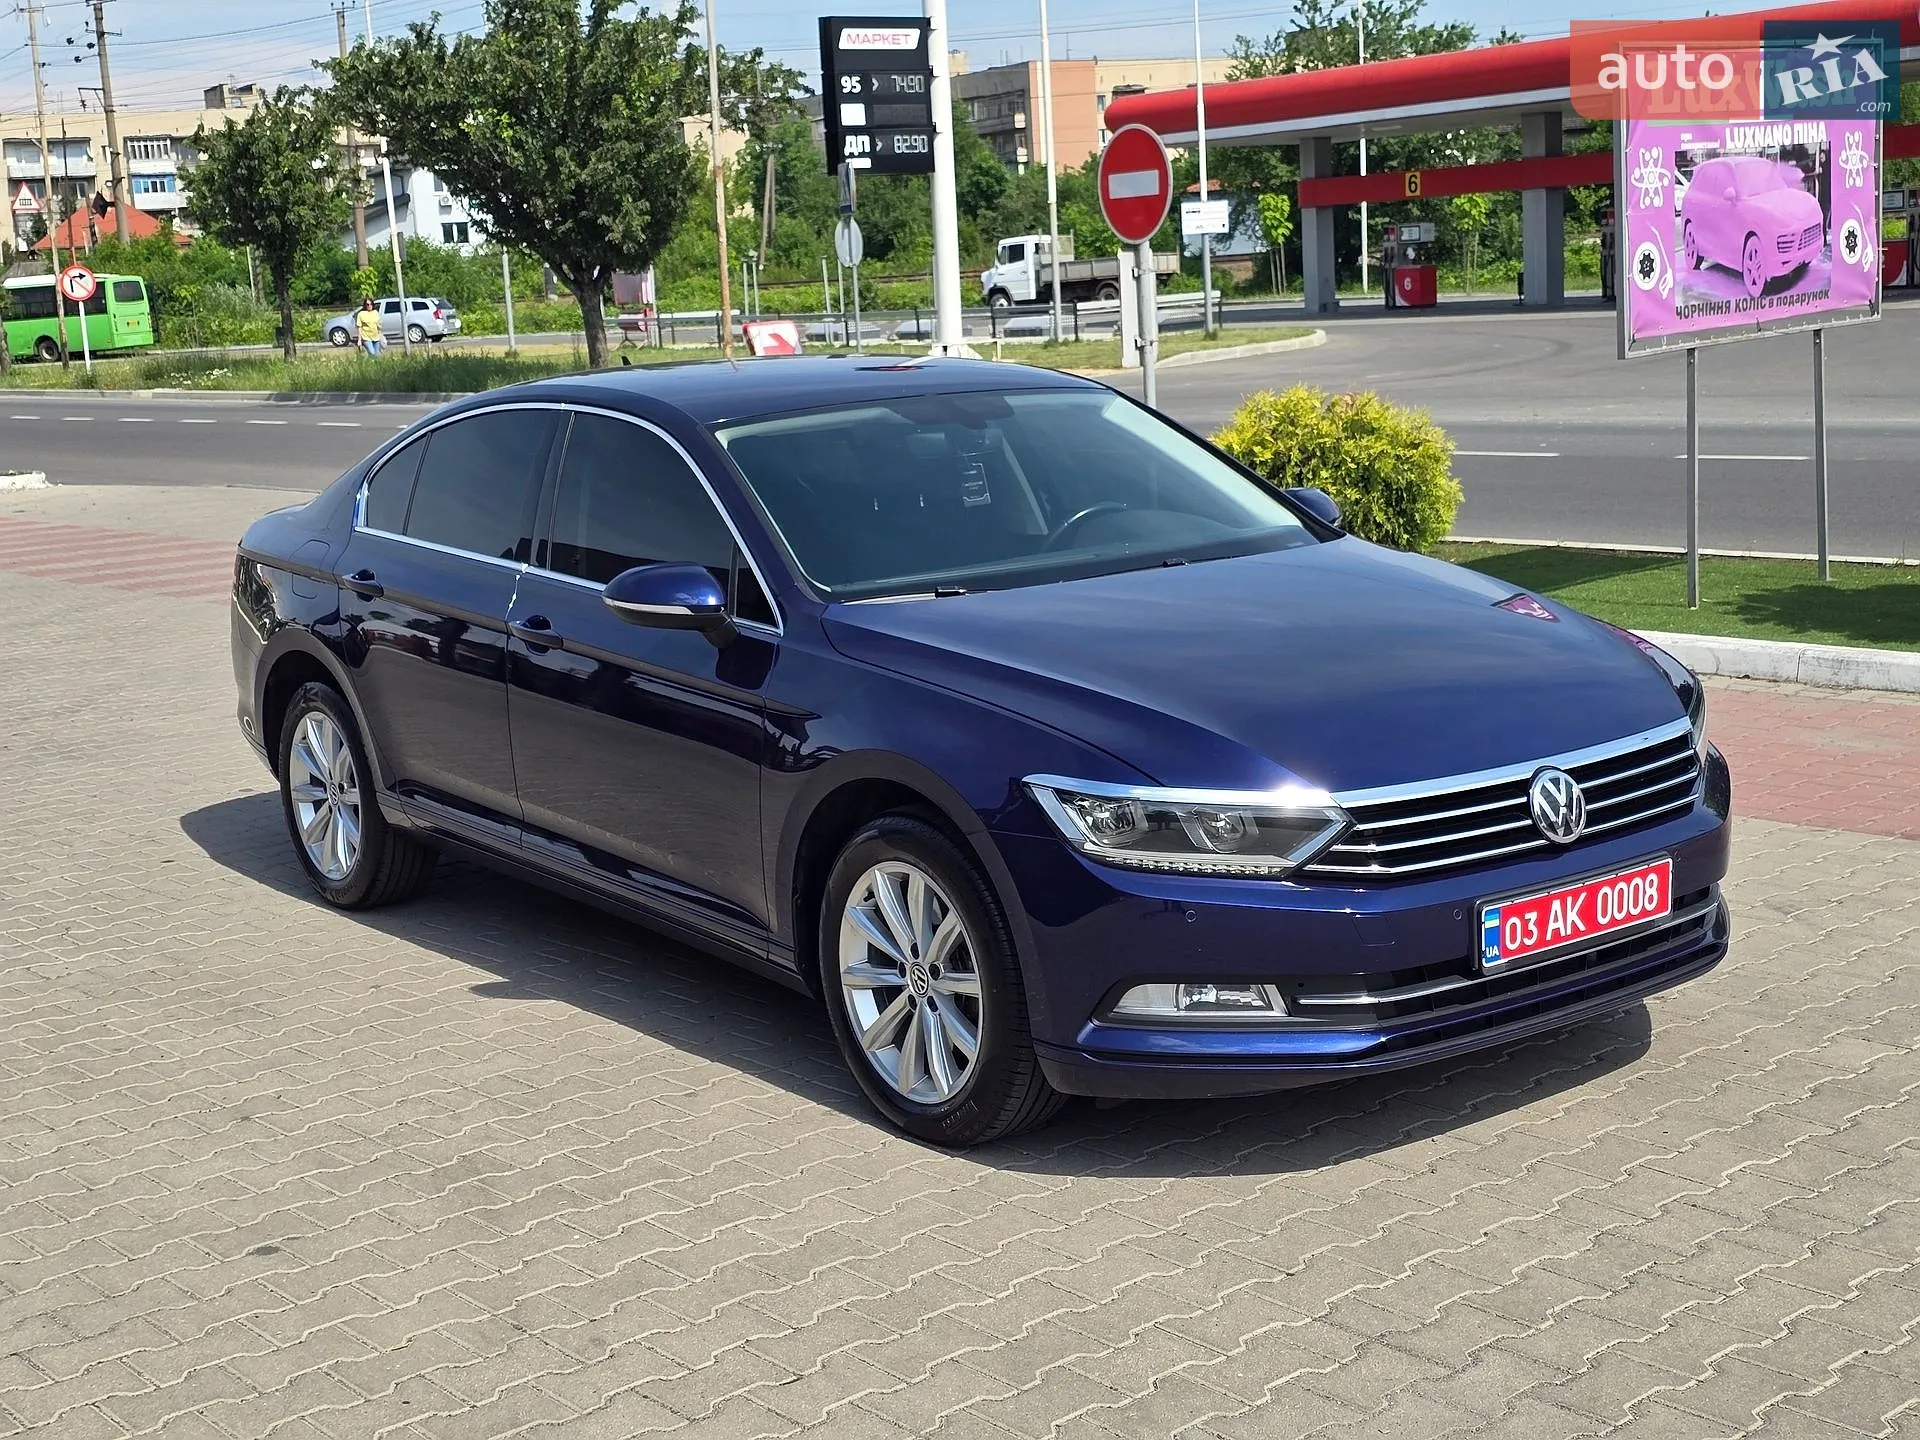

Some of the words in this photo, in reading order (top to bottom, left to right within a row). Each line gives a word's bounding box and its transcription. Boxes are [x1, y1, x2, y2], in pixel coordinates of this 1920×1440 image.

[846, 33, 912, 46] МАРКЕТ
[840, 75, 862, 94] 95
[843, 135, 871, 156] ДП
[1725, 123, 1793, 150] LUXNANO
[1793, 121, 1828, 145] ПІНА
[1408, 174, 1418, 194] 6
[1675, 301, 1731, 321] ЧОРНІННЯ
[1734, 296, 1767, 313] КОЛІС
[1769, 300, 1774, 309] в
[1776, 289, 1830, 309] подарунок
[1505, 911, 1538, 951] 03
[1596, 872, 1659, 926] 0008
[1485, 945, 1500, 958] UA
